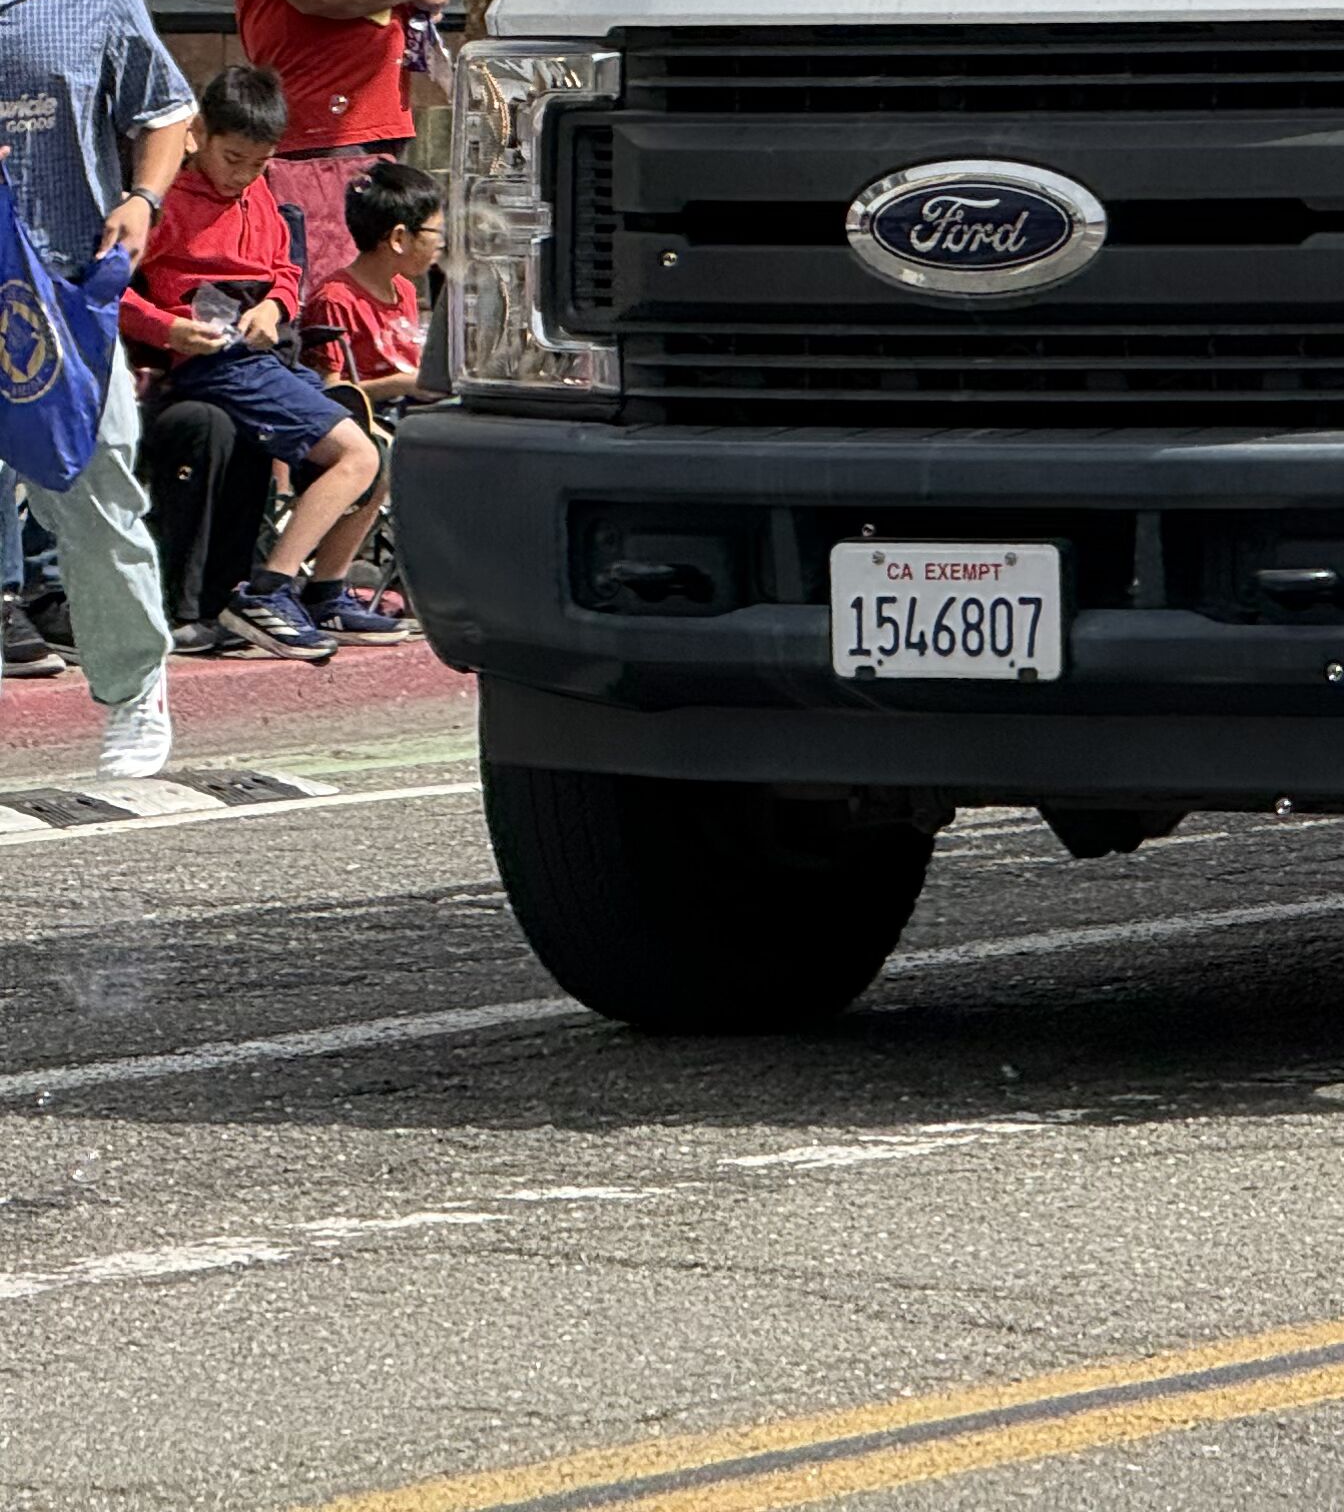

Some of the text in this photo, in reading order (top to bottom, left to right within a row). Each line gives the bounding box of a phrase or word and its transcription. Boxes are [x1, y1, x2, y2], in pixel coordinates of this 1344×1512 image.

[909, 195, 1030, 253] Ford
[886, 562, 1004, 582] CA EXEMPT
[848, 595, 1043, 659] 1546807
